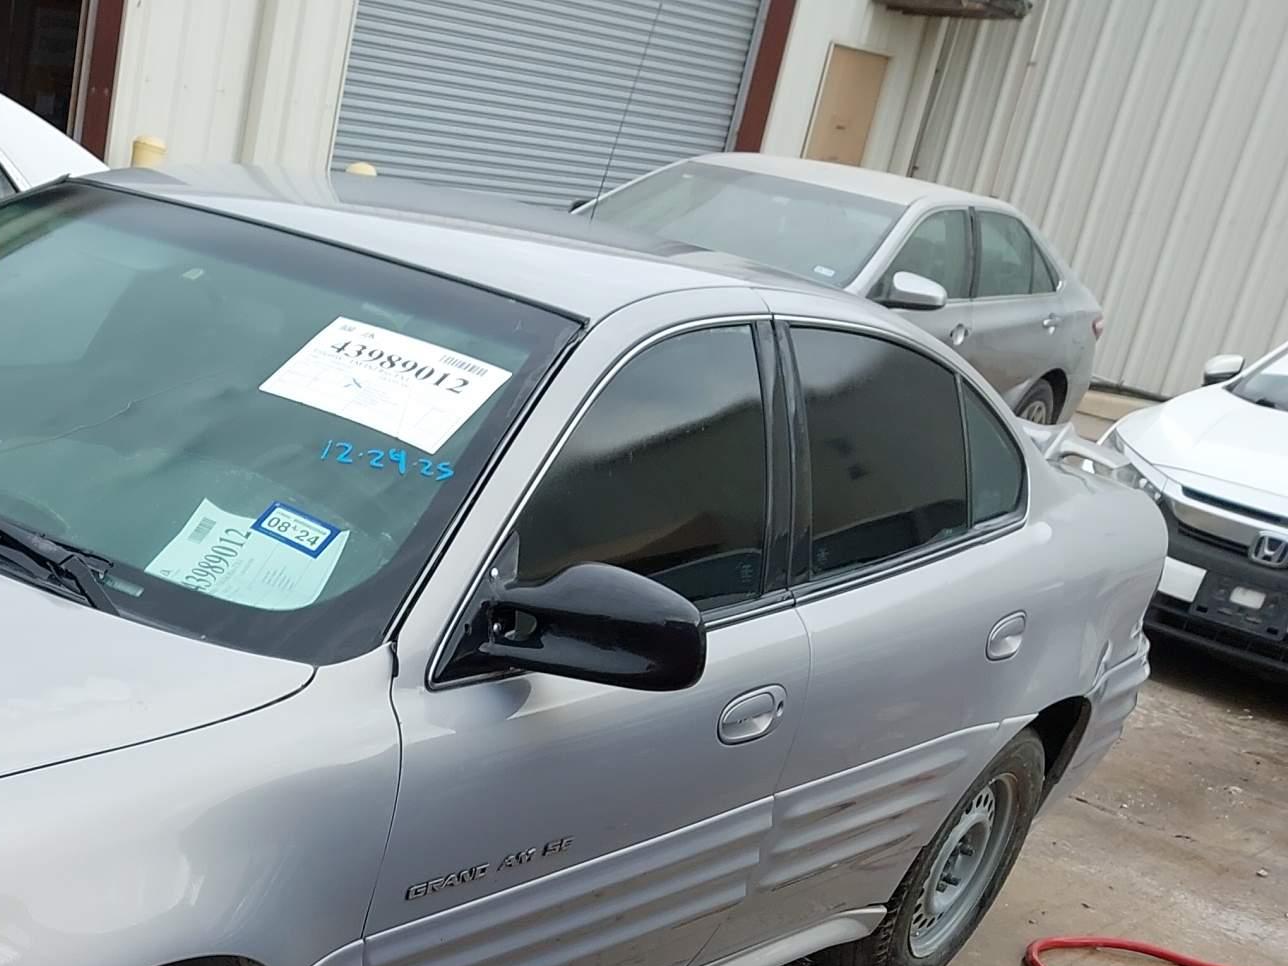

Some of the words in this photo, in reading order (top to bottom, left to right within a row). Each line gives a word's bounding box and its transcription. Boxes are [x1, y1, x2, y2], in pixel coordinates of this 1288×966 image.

[330, 340, 470, 395] 43989012
[267, 516, 291, 533] 08
[295, 529, 320, 547] 24
[405, 862, 490, 900] GRAND
